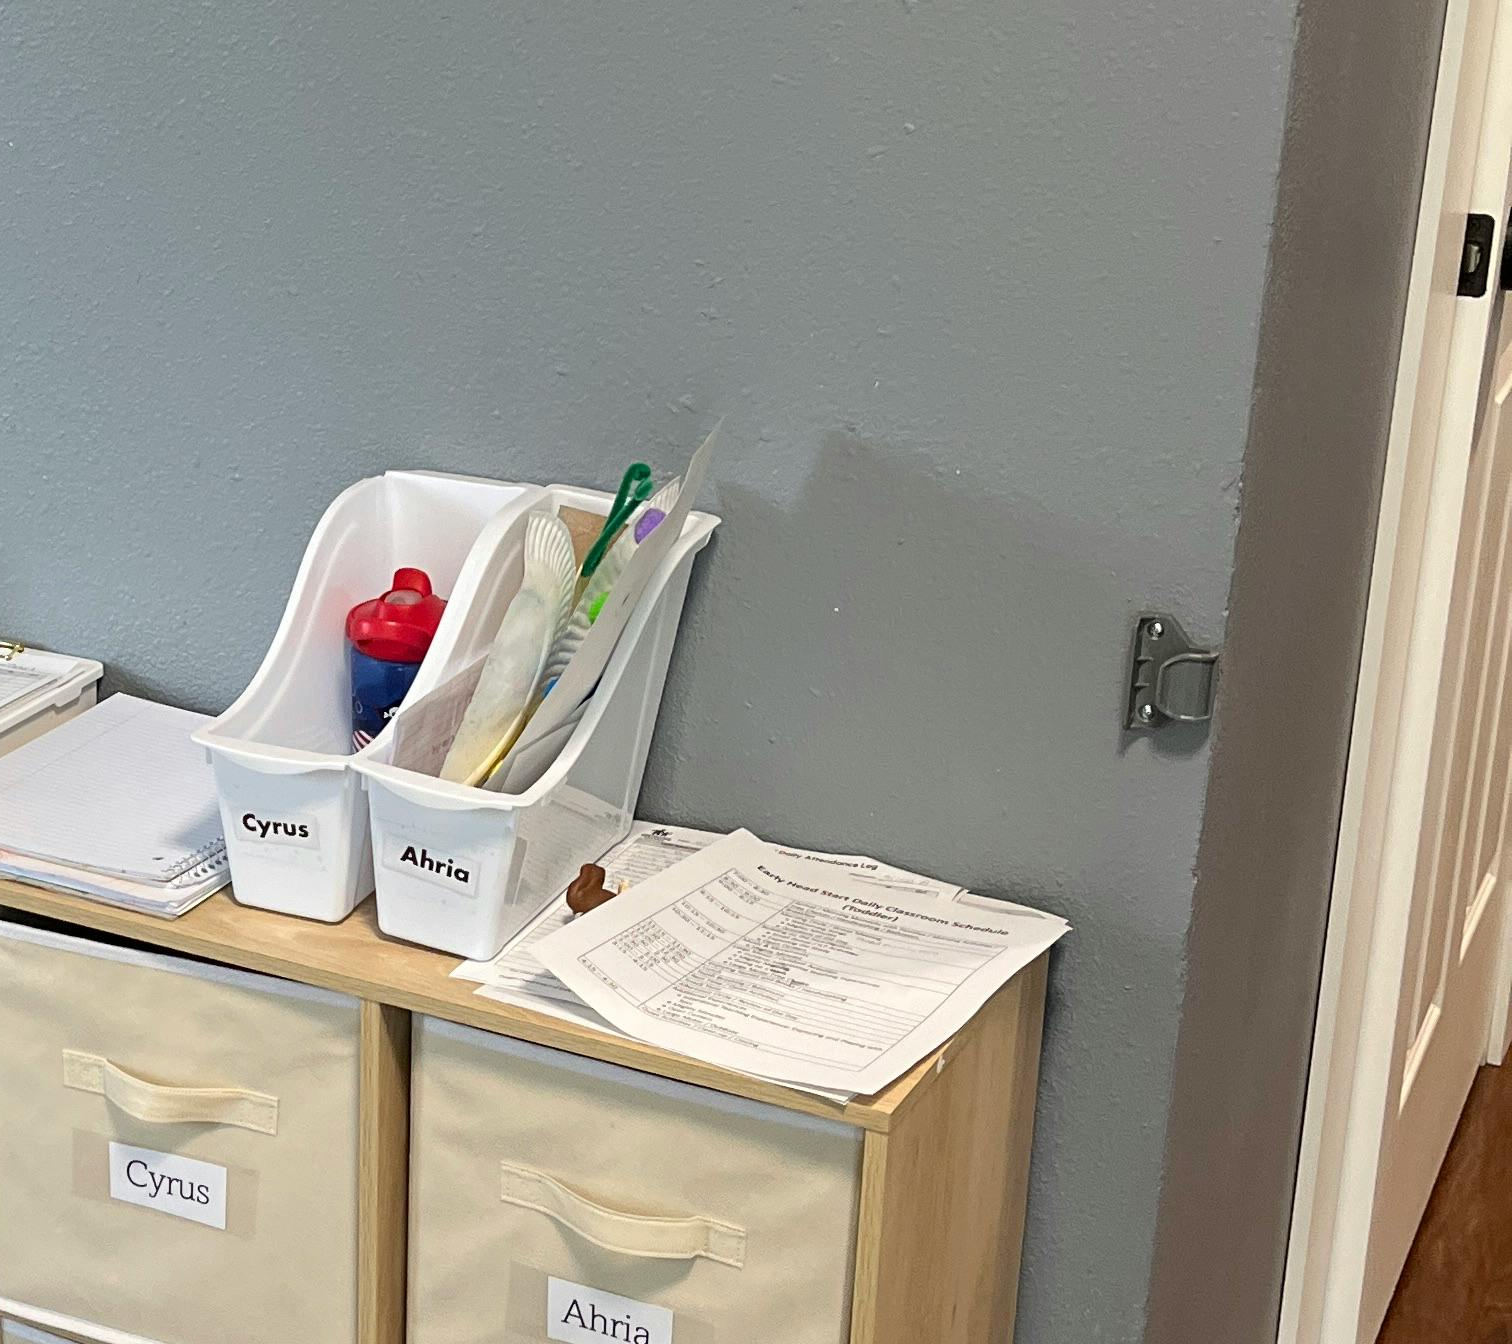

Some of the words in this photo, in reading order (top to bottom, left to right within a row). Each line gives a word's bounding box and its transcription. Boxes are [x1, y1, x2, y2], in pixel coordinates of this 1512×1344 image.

[242, 814, 309, 839] Cyrus
[400, 846, 469, 883] Ahria
[804, 855, 859, 869] Attendance
[860, 863, 879, 871] Log
[757, 865, 785, 884] Early
[787, 881, 819, 894] Head
[821, 889, 850, 903] Start
[851, 898, 881, 911] Daily
[885, 906, 949, 925] Classroom
[951, 921, 1009, 936] Schedule
[842, 905, 899, 923] (Toddler)
[126, 1160, 210, 1205] Cyrus
